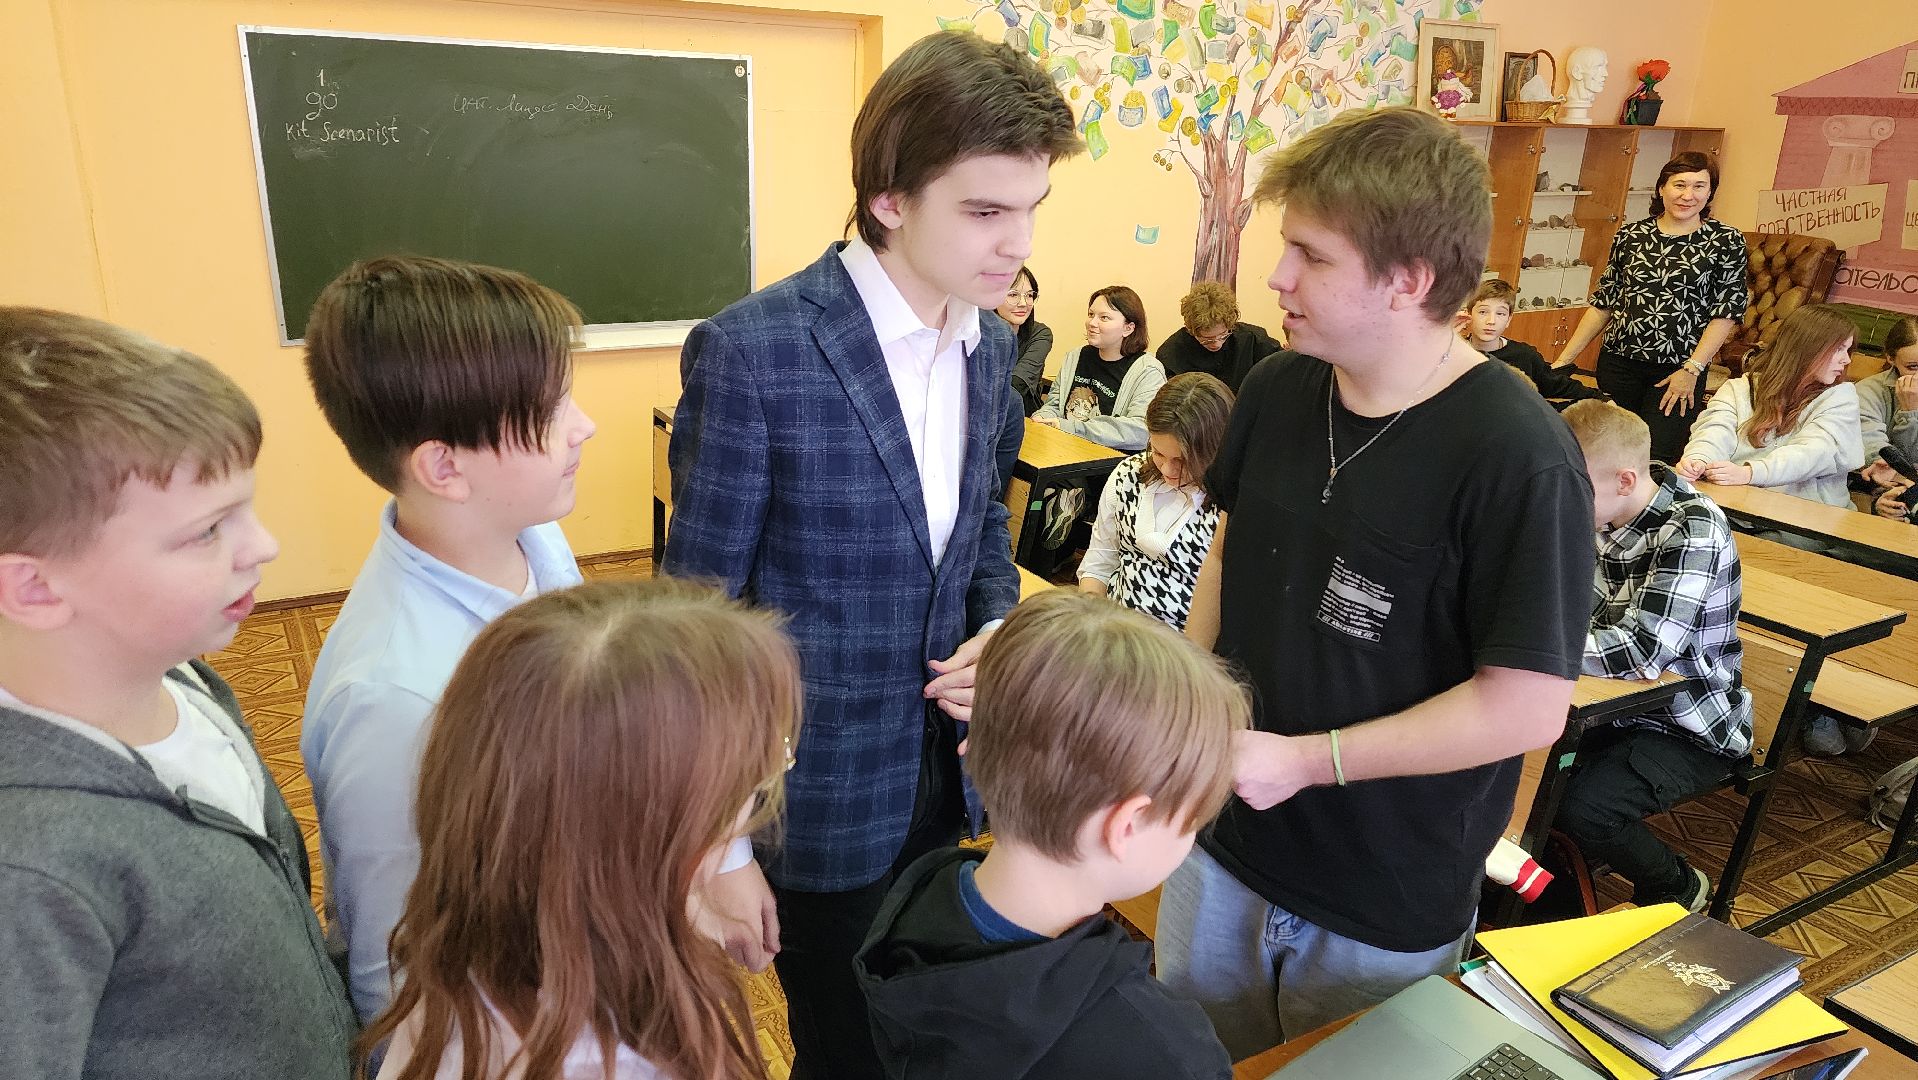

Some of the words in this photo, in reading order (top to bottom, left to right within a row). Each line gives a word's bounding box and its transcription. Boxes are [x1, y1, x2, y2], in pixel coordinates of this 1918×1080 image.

[320, 116, 400, 146] Scenarist
[1775, 187, 1848, 213] ЧАСТНАЯ
[1757, 201, 1881, 235] СОБСТВЕННОСТЬ
